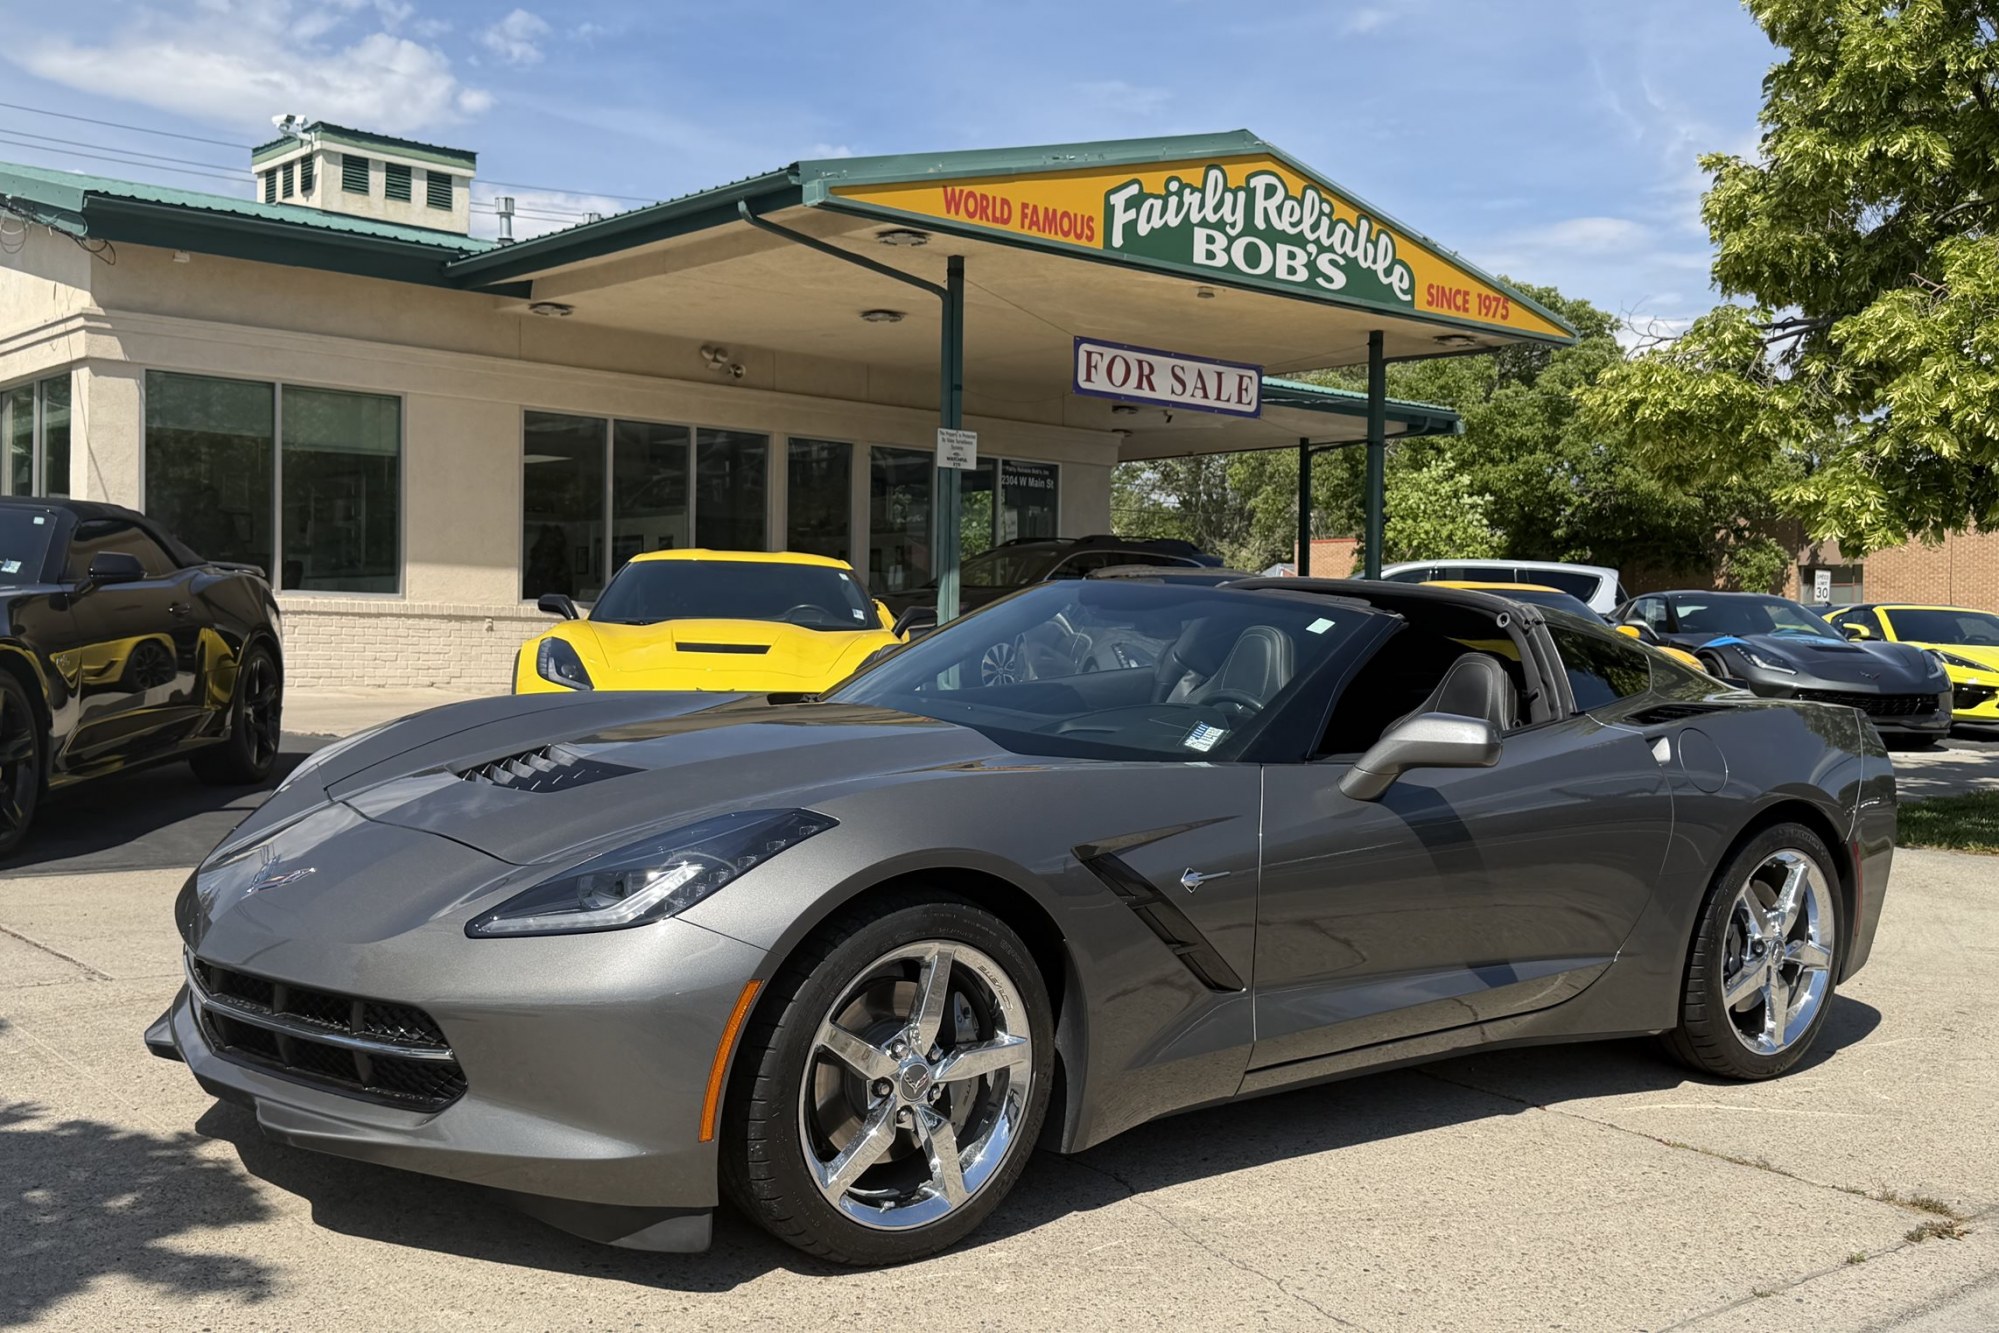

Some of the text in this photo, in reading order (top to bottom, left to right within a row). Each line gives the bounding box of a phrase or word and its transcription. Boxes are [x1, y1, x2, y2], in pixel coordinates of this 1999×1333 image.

[943, 185, 1095, 242] WORLD FAMOUS
[1109, 168, 1412, 301] Fairly Reliable
[1193, 226, 1347, 290] BOB'S
[1426, 283, 1510, 320] SINCE 1975
[1082, 350, 1253, 406] FOR SALE
[1001, 475, 1054, 489] 2304 W Main St
[1816, 587, 1828, 598] 30
